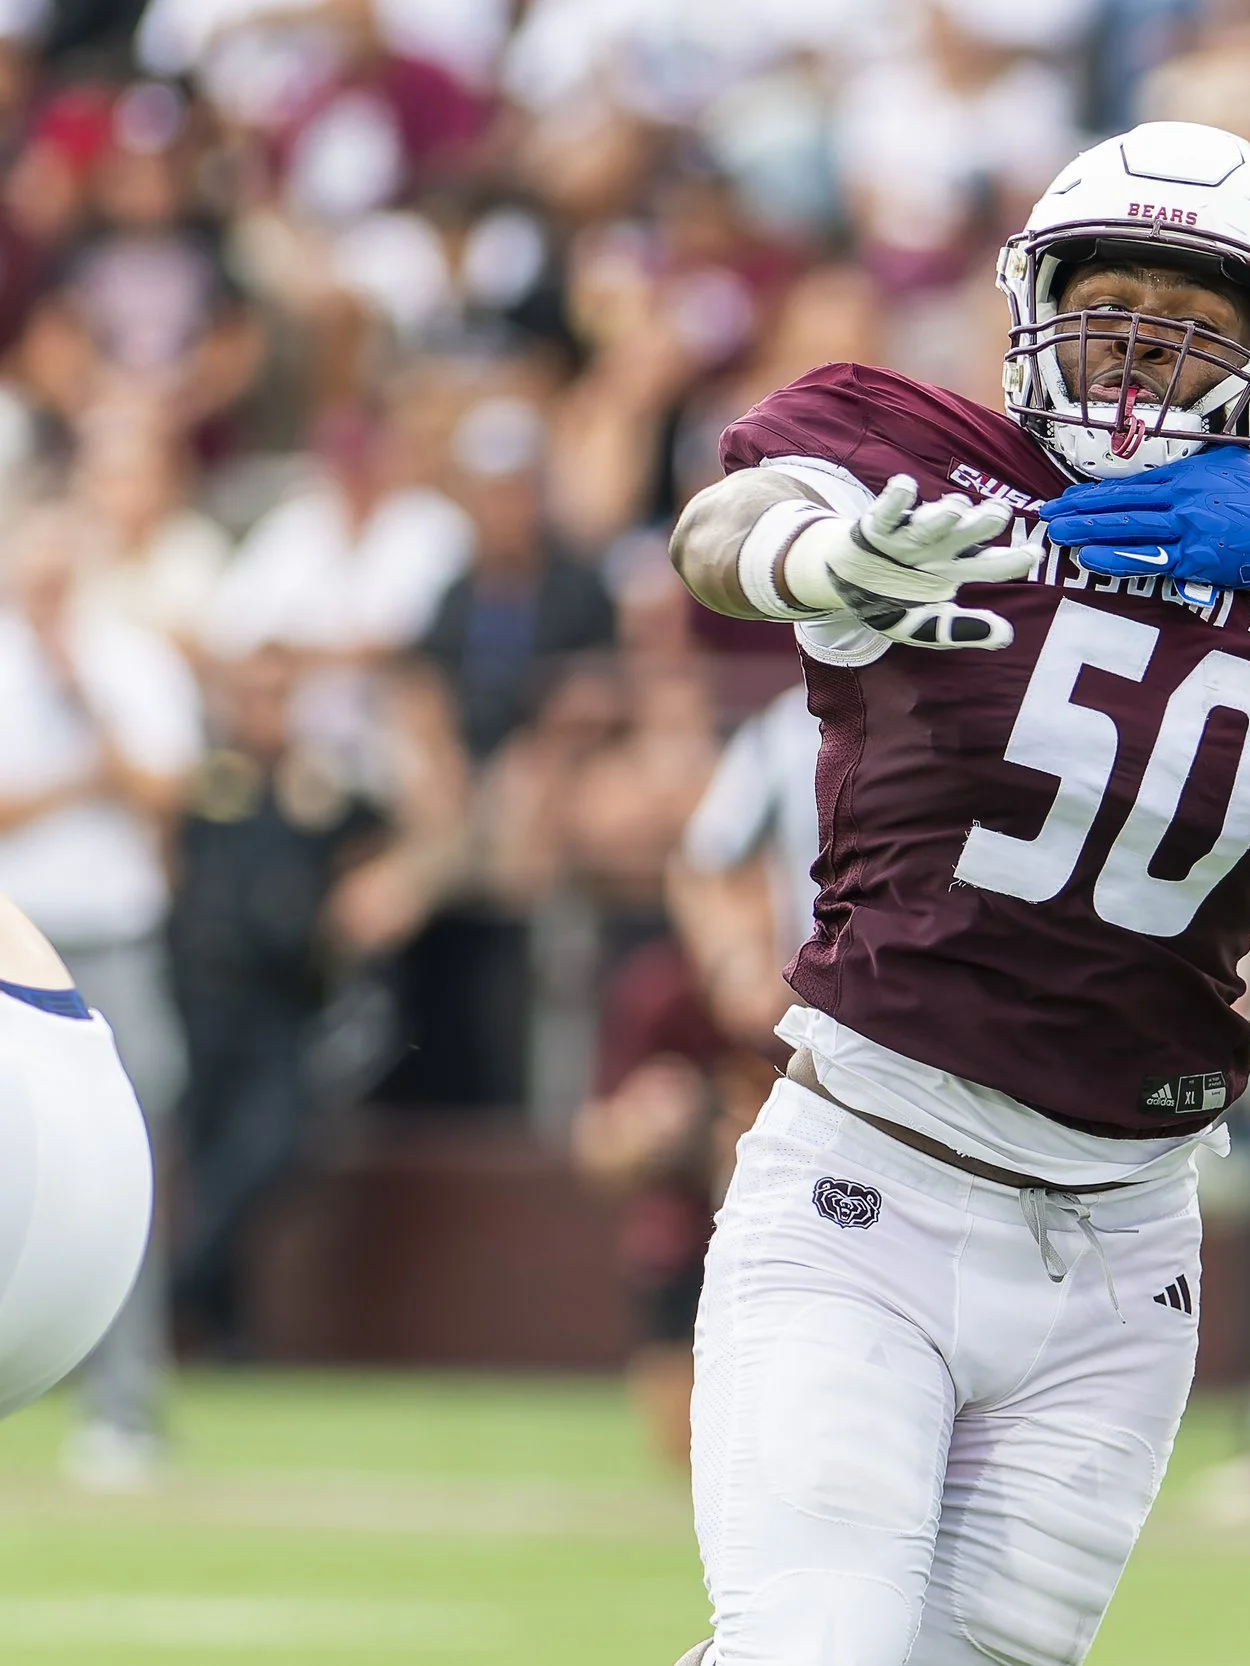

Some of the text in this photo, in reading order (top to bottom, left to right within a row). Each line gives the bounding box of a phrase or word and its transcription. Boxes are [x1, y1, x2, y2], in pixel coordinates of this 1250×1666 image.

[1128, 203, 1198, 225] BEARS
[1146, 1097, 1175, 1107] adidas
[1185, 1091, 1195, 1105] XL
